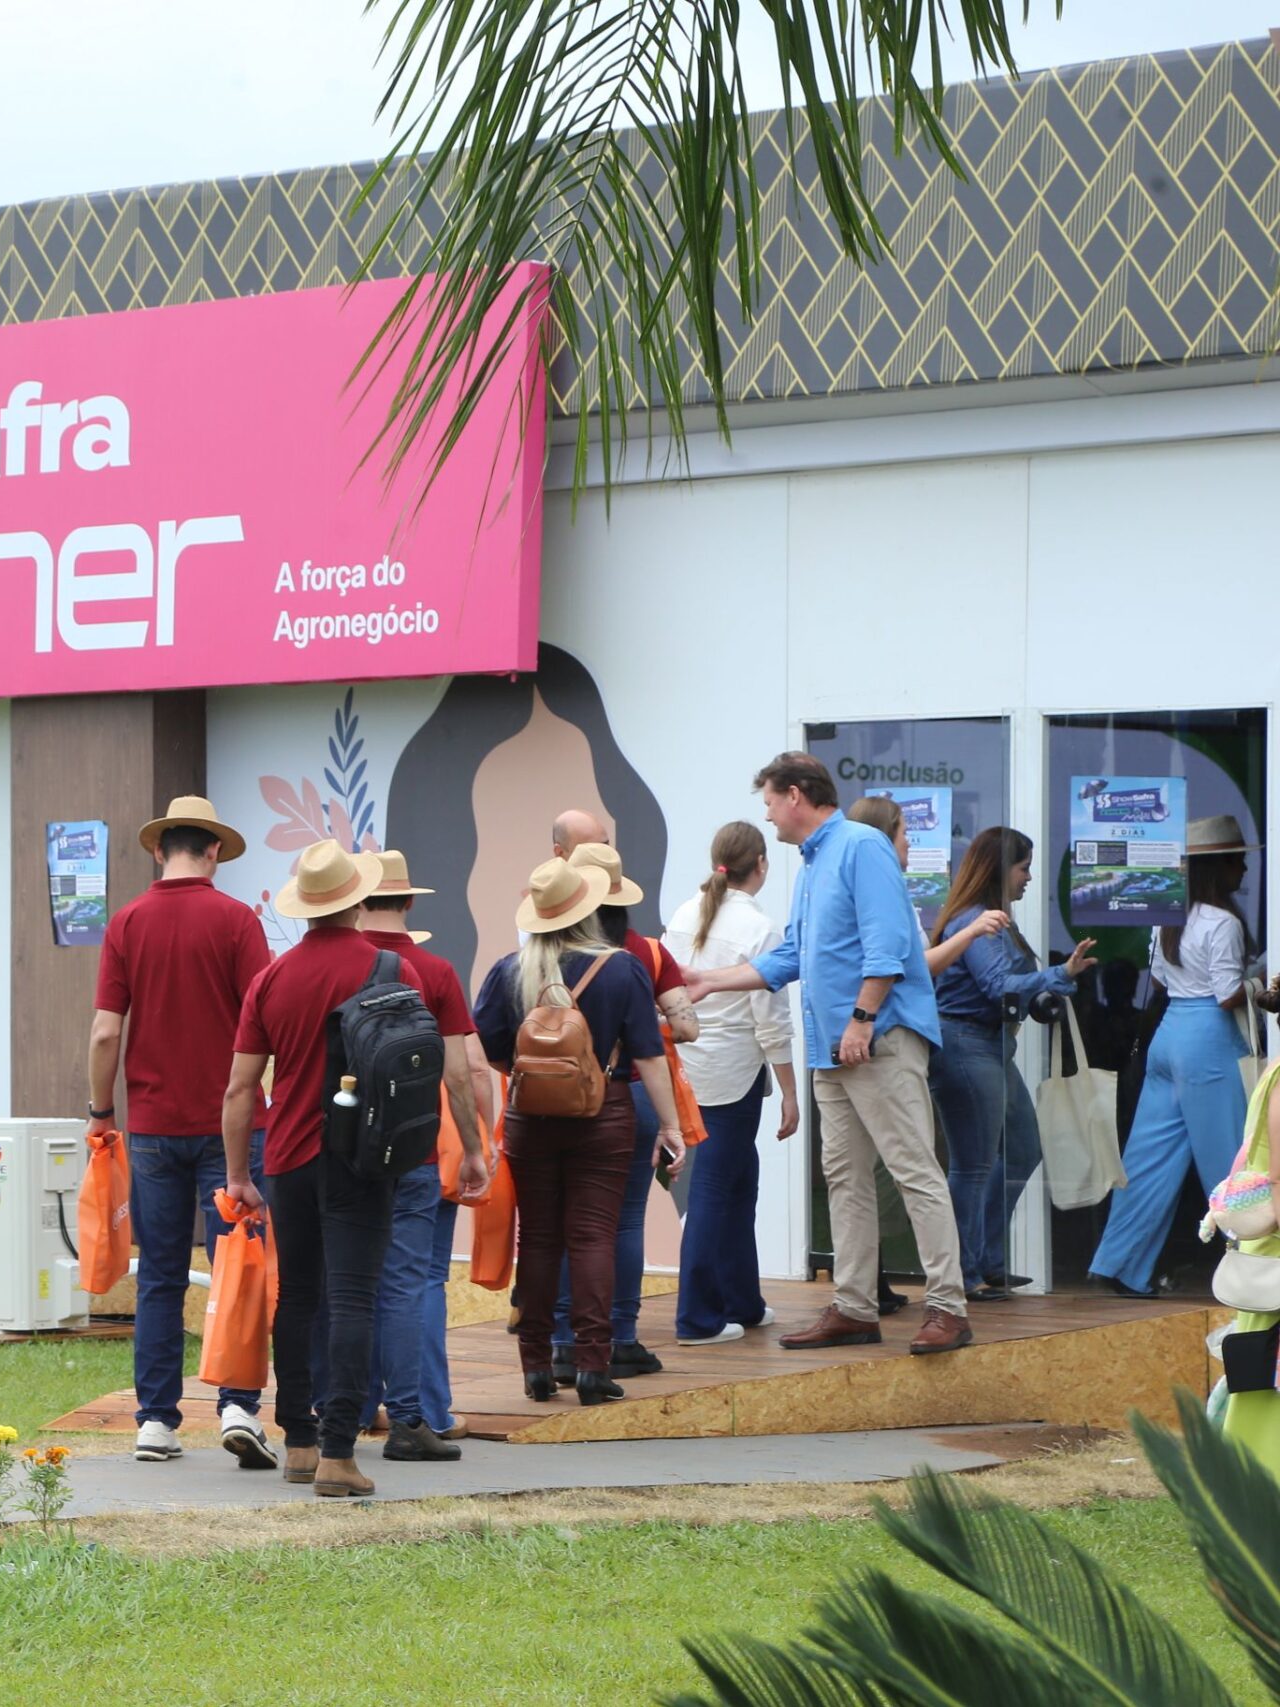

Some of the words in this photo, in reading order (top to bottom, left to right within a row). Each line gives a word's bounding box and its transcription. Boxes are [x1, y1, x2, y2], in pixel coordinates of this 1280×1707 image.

[274, 562, 295, 593] A
[300, 560, 366, 597] força
[372, 554, 406, 587] do
[273, 602, 439, 649] Agronegócio
[837, 757, 964, 785] Conclusão
